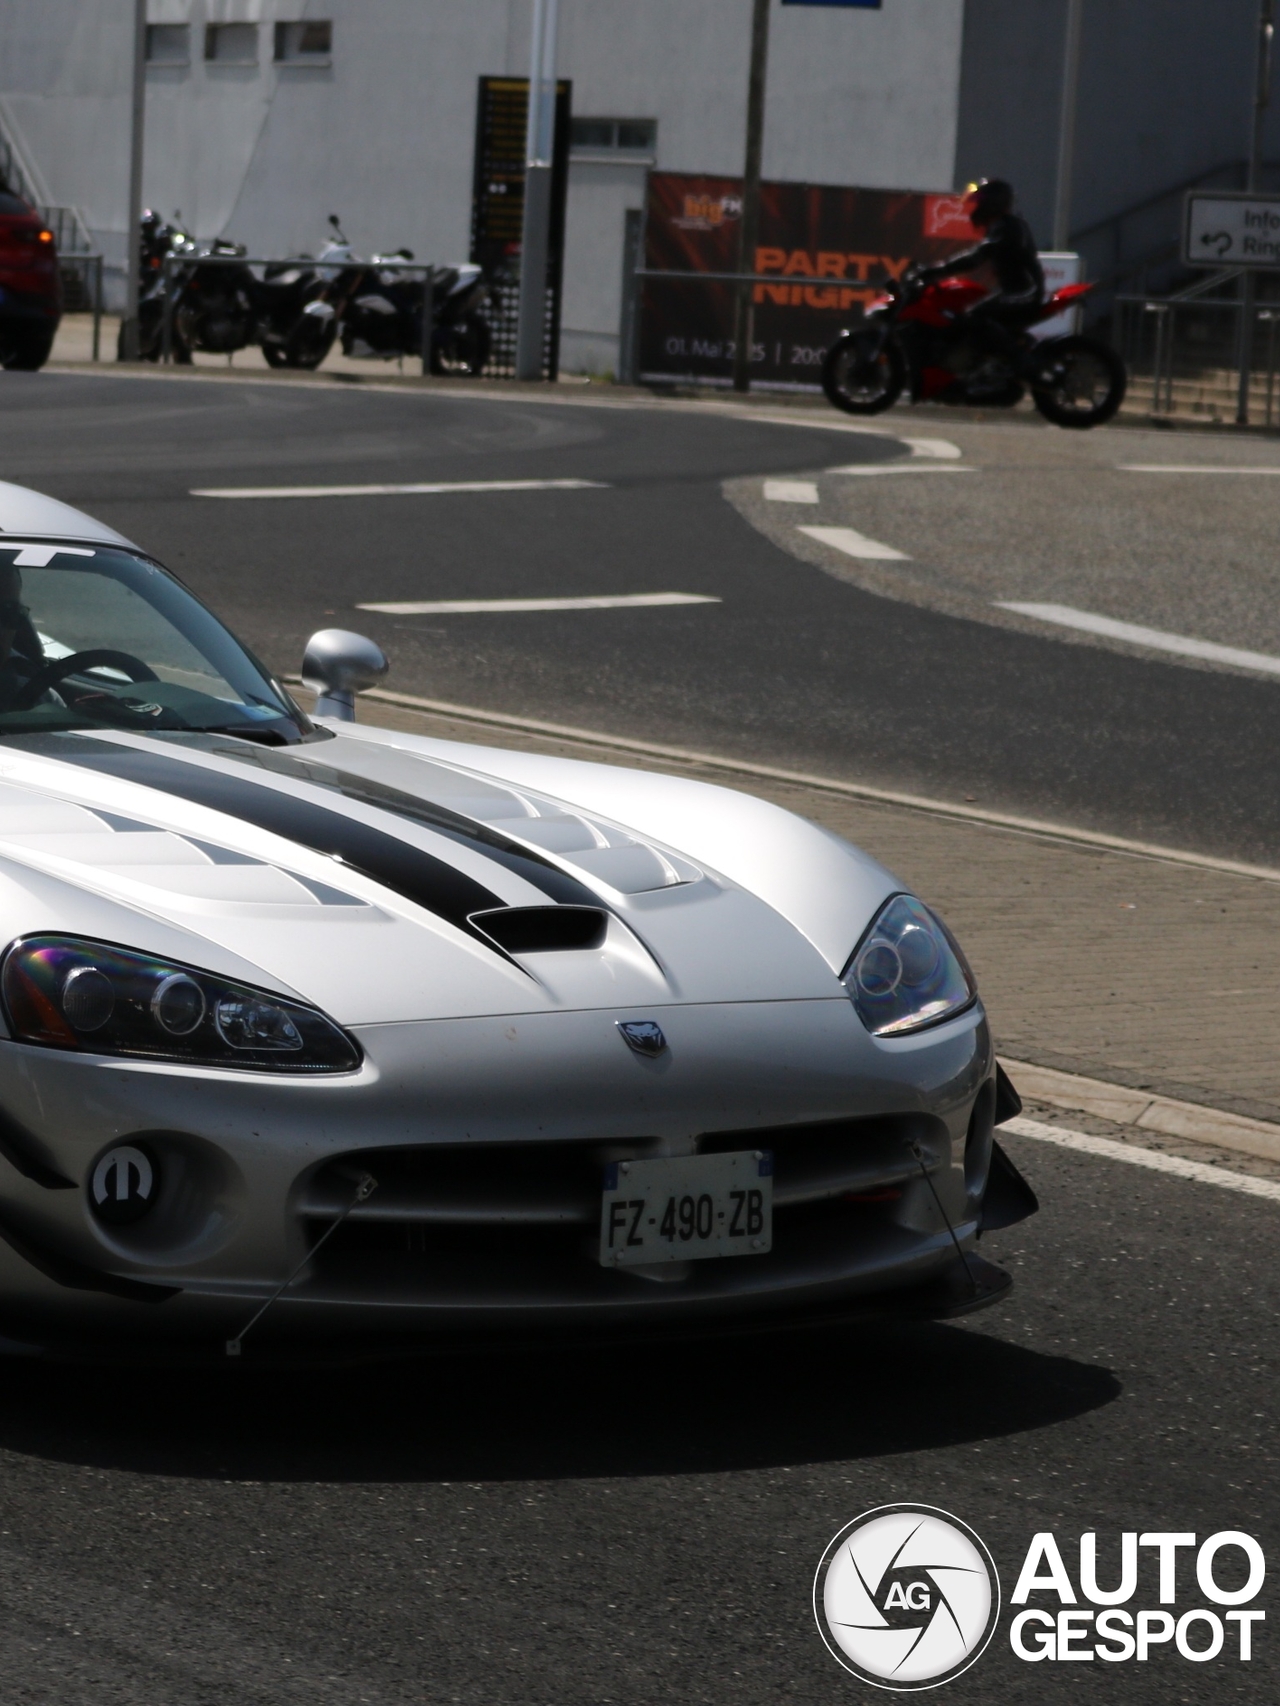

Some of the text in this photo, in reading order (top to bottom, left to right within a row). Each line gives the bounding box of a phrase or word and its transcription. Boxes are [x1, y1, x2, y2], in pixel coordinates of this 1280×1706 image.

[754, 246, 911, 283] PARTY
[753, 283, 880, 311] NIGH
[691, 340, 722, 358] Mai
